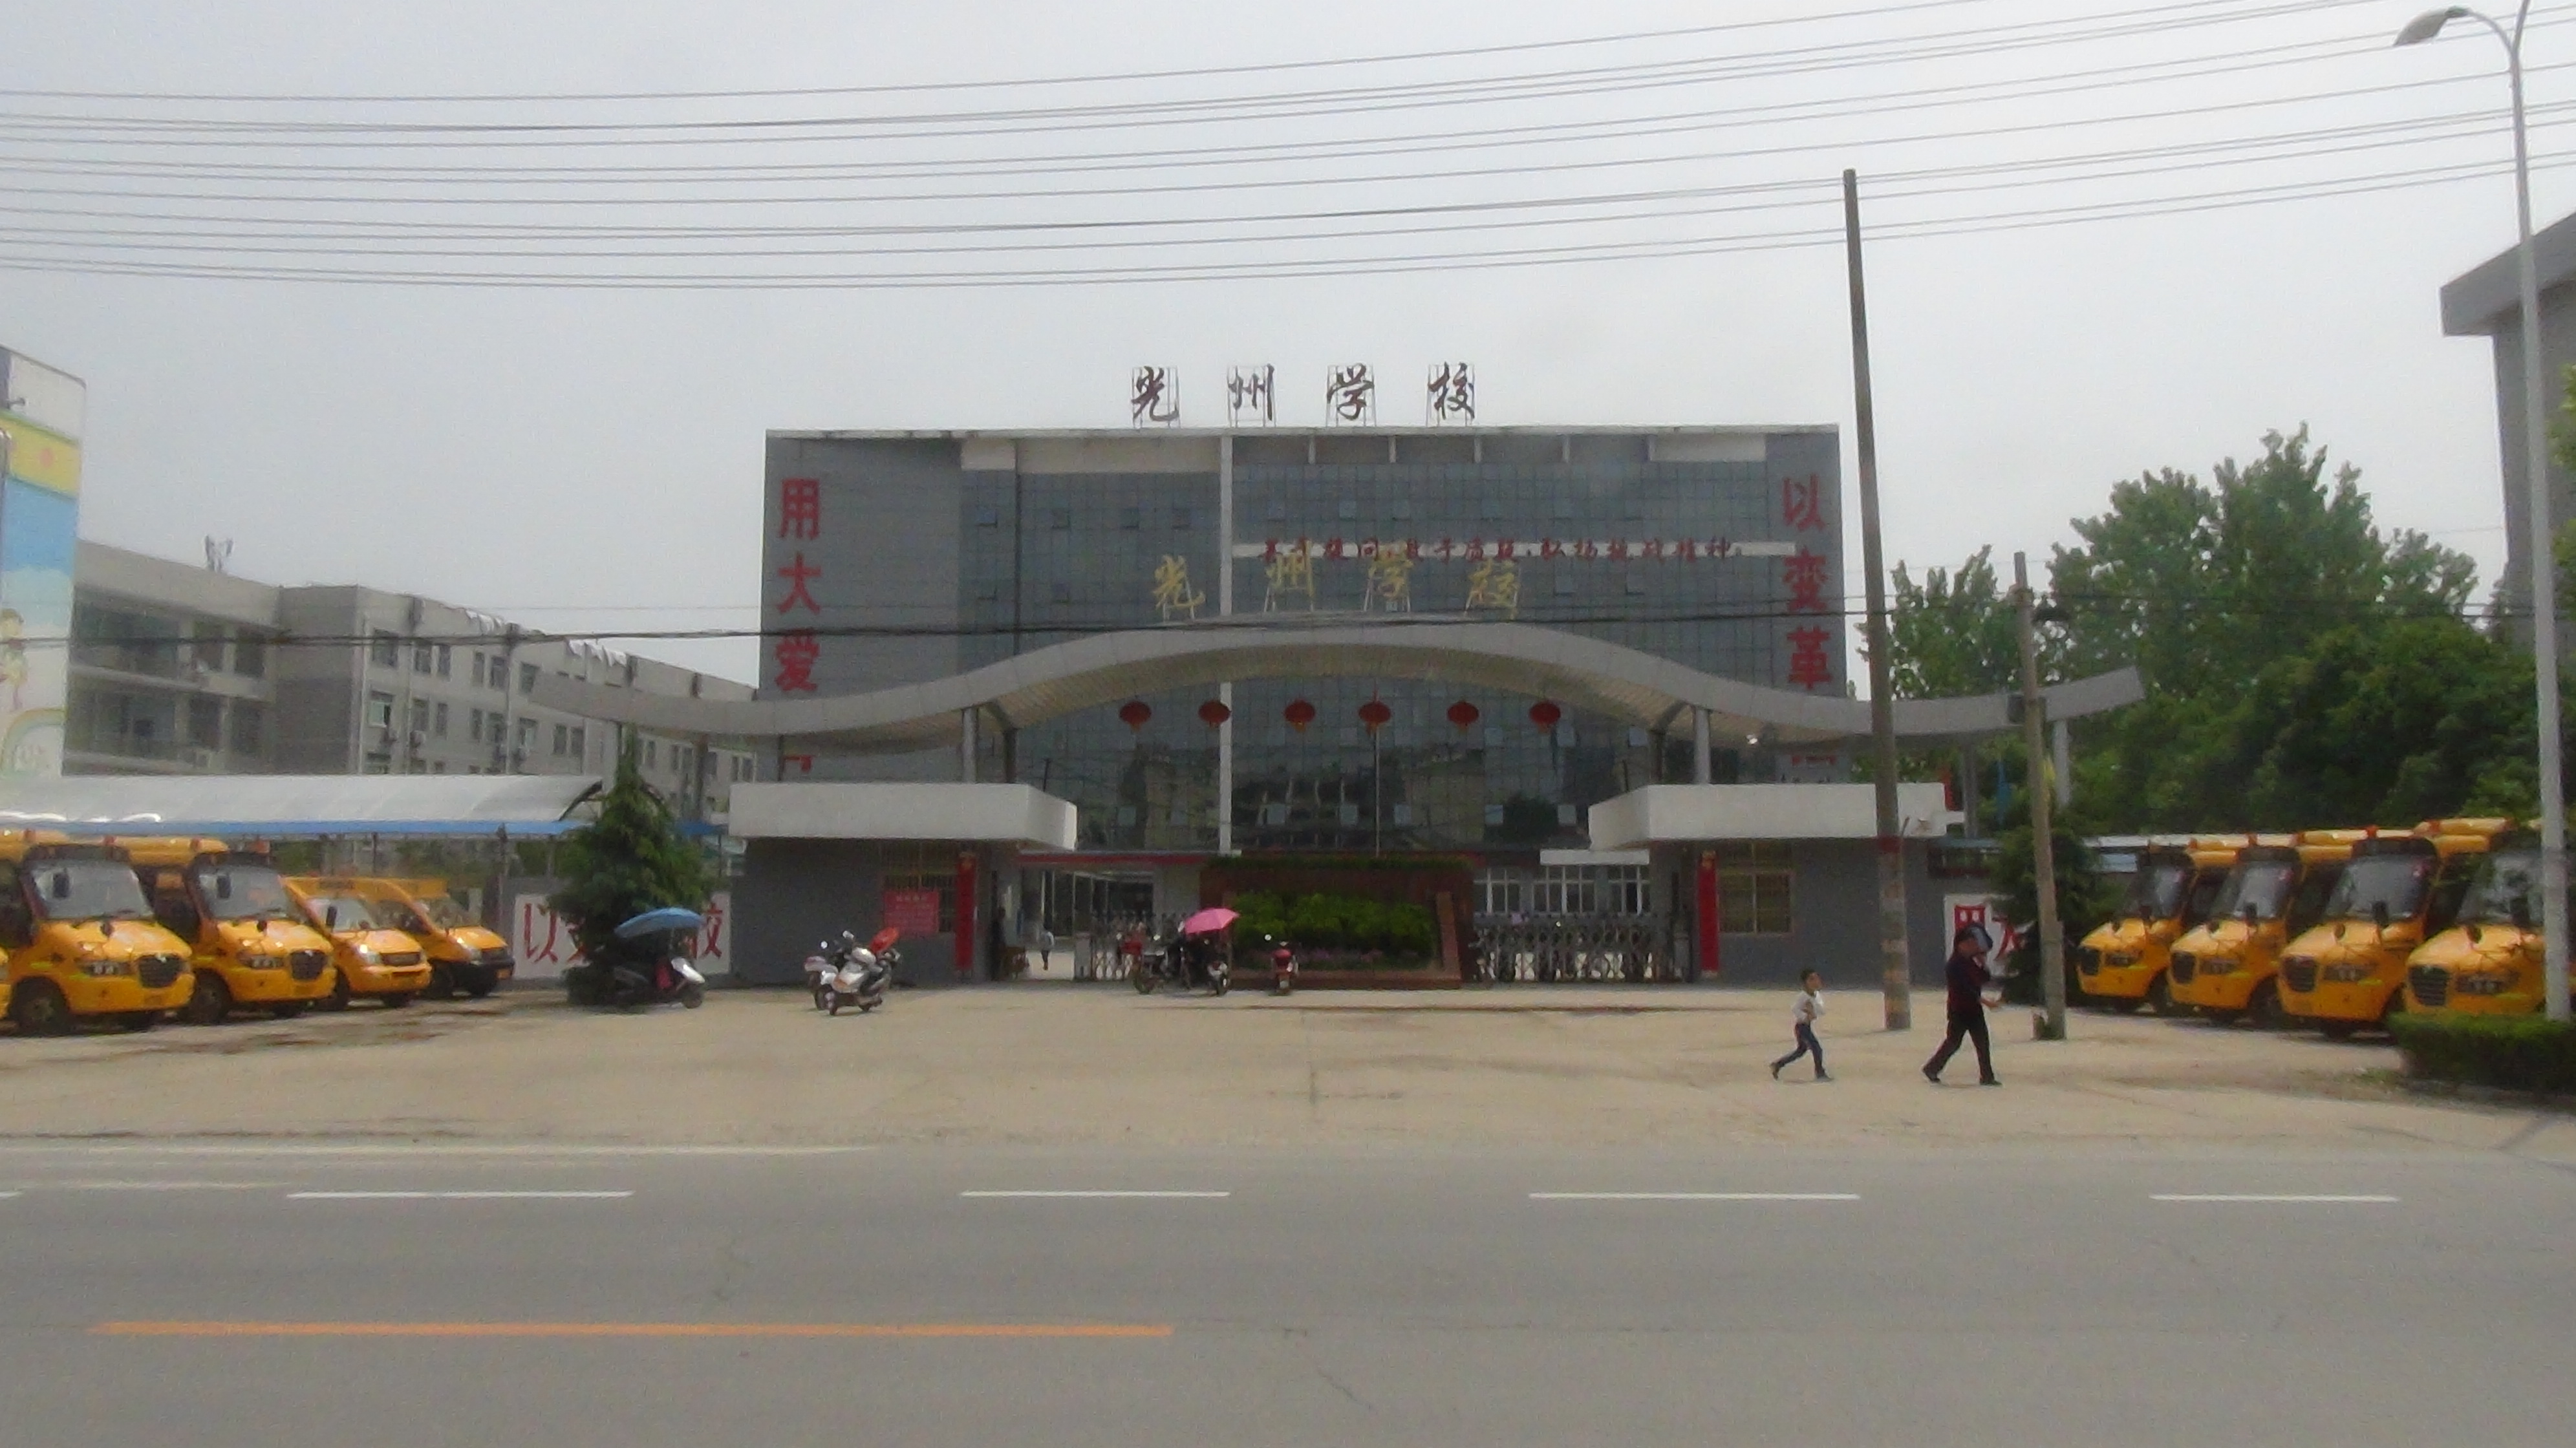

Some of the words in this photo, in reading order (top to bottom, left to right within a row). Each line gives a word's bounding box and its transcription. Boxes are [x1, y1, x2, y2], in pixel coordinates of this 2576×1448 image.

[1132, 361, 1475, 421] 光州学校
[775, 477, 821, 692] 用大爱
[1153, 542, 1518, 621] 光州学校
[1782, 473, 1834, 691] 以变革
